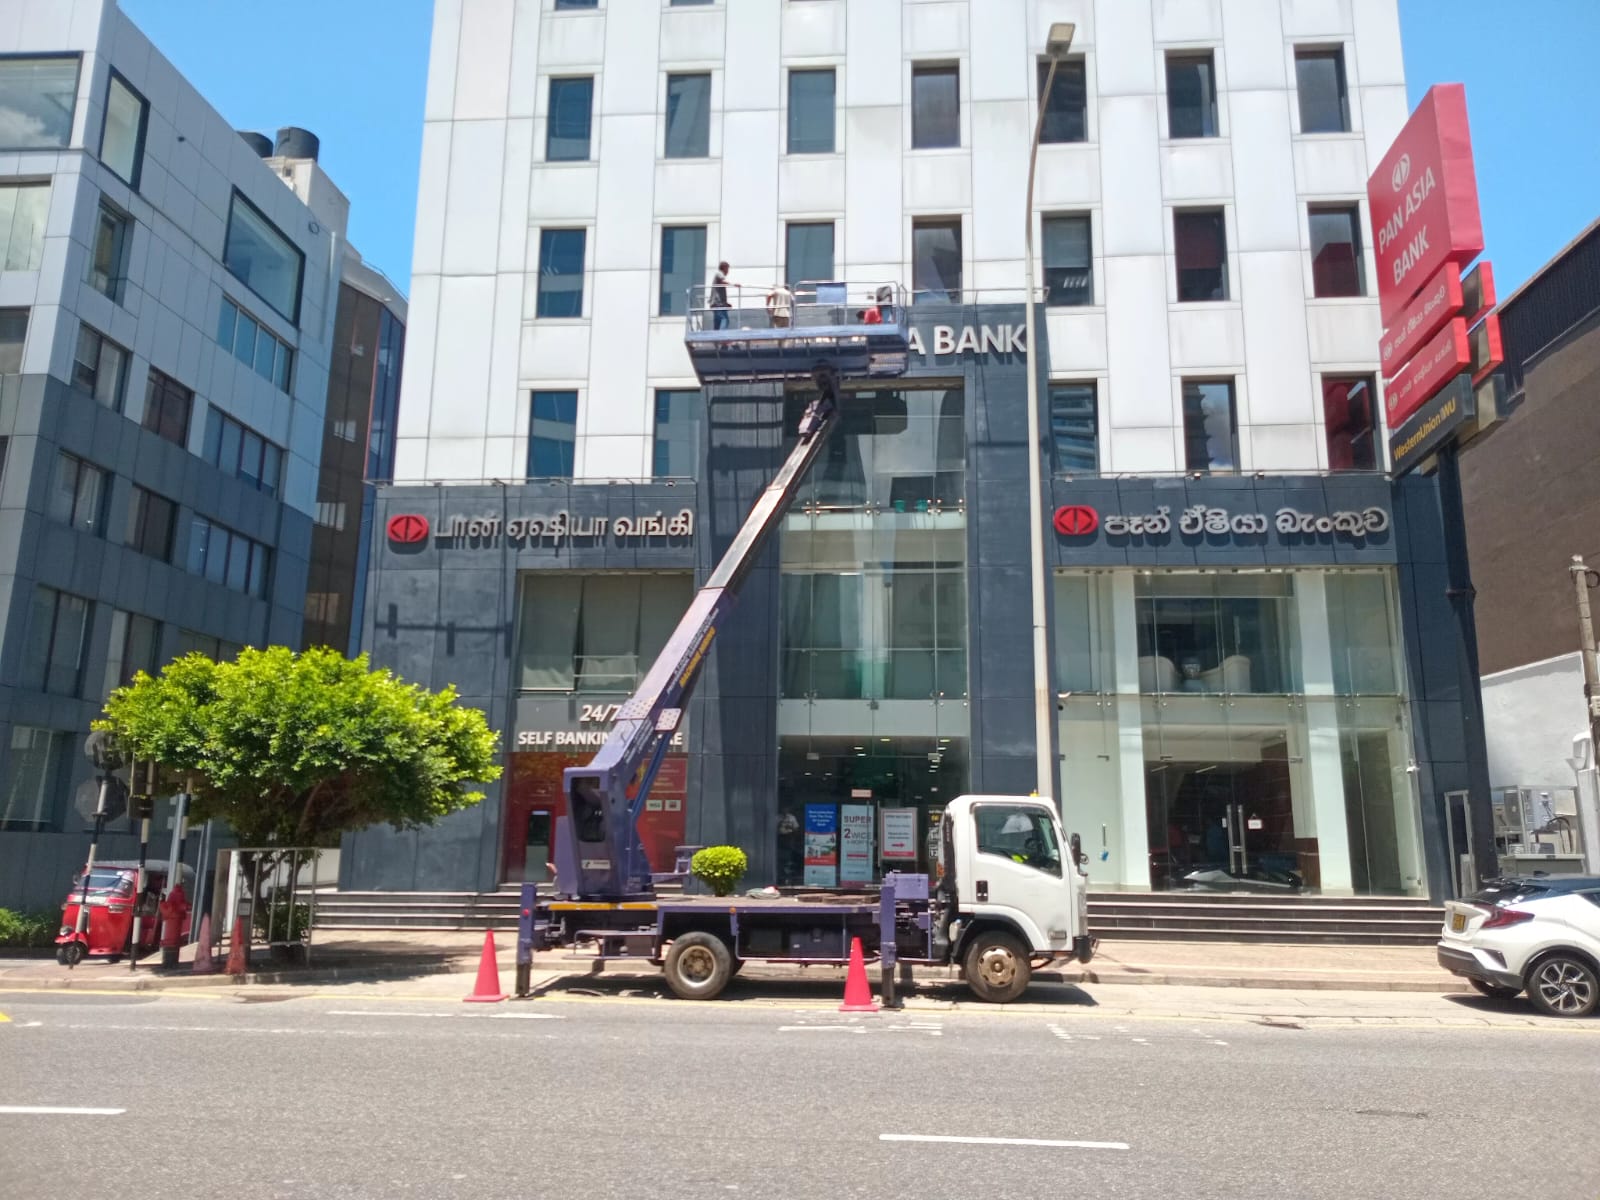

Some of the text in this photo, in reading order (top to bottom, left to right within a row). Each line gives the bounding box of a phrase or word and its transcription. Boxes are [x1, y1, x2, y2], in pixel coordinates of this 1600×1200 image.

[1378, 165, 1436, 256] PAN ASIA
[1393, 225, 1430, 287] BANK
[933, 324, 1027, 355] BANK
[434, 508, 694, 546] பான் ஏஷியா வங்கி
[1275, 506, 1389, 537] බැංකුව
[579, 704, 622, 722] 24/7
[518, 731, 610, 745] SELF BANKIN
